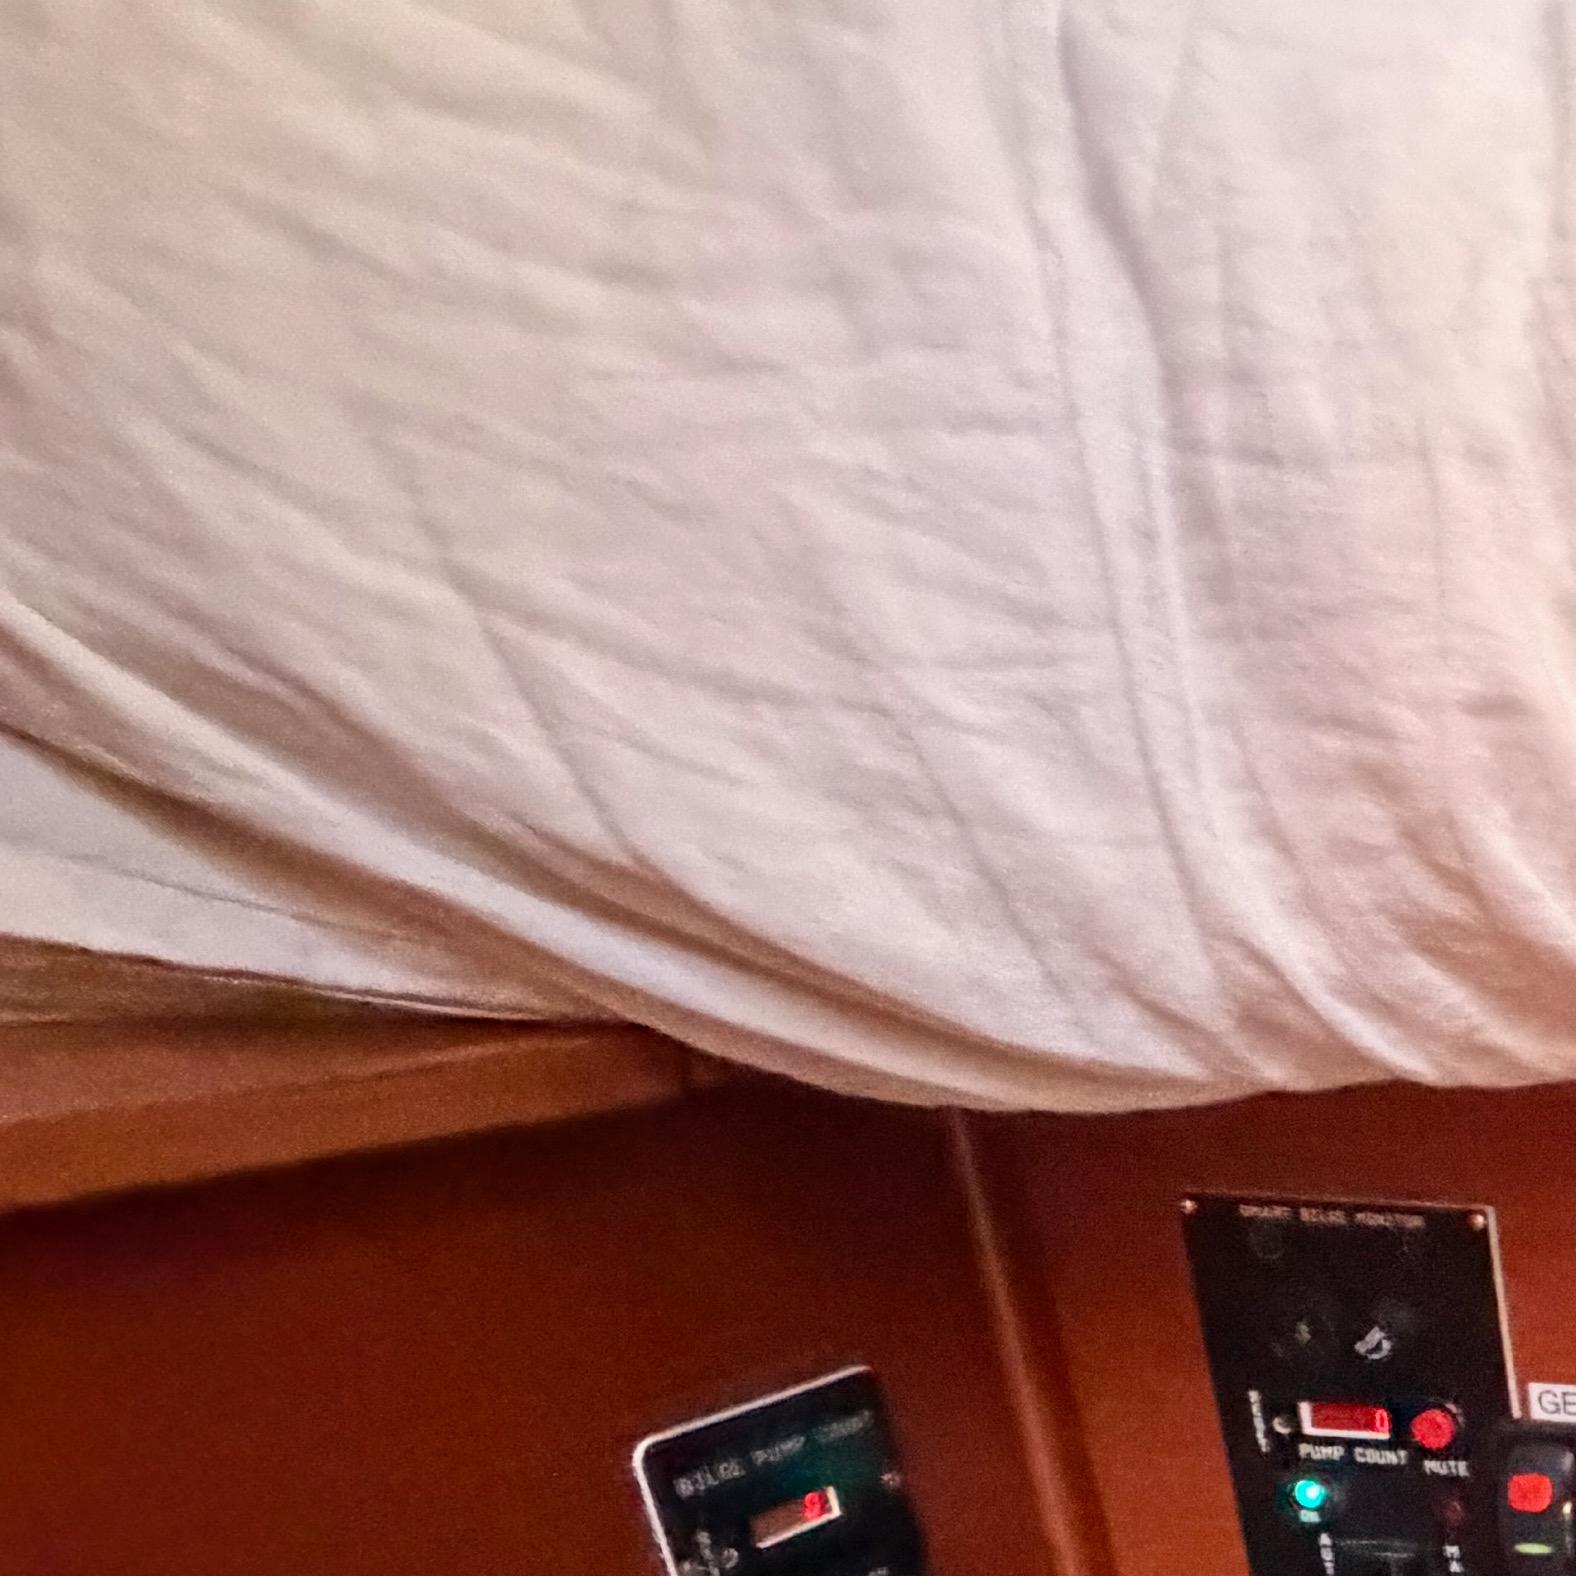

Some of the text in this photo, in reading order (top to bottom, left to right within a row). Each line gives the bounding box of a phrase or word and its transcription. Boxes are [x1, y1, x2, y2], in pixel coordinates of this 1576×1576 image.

[1299, 1442, 1408, 1466] PUMP COUNT
[1422, 1459, 1470, 1478] MUTE
